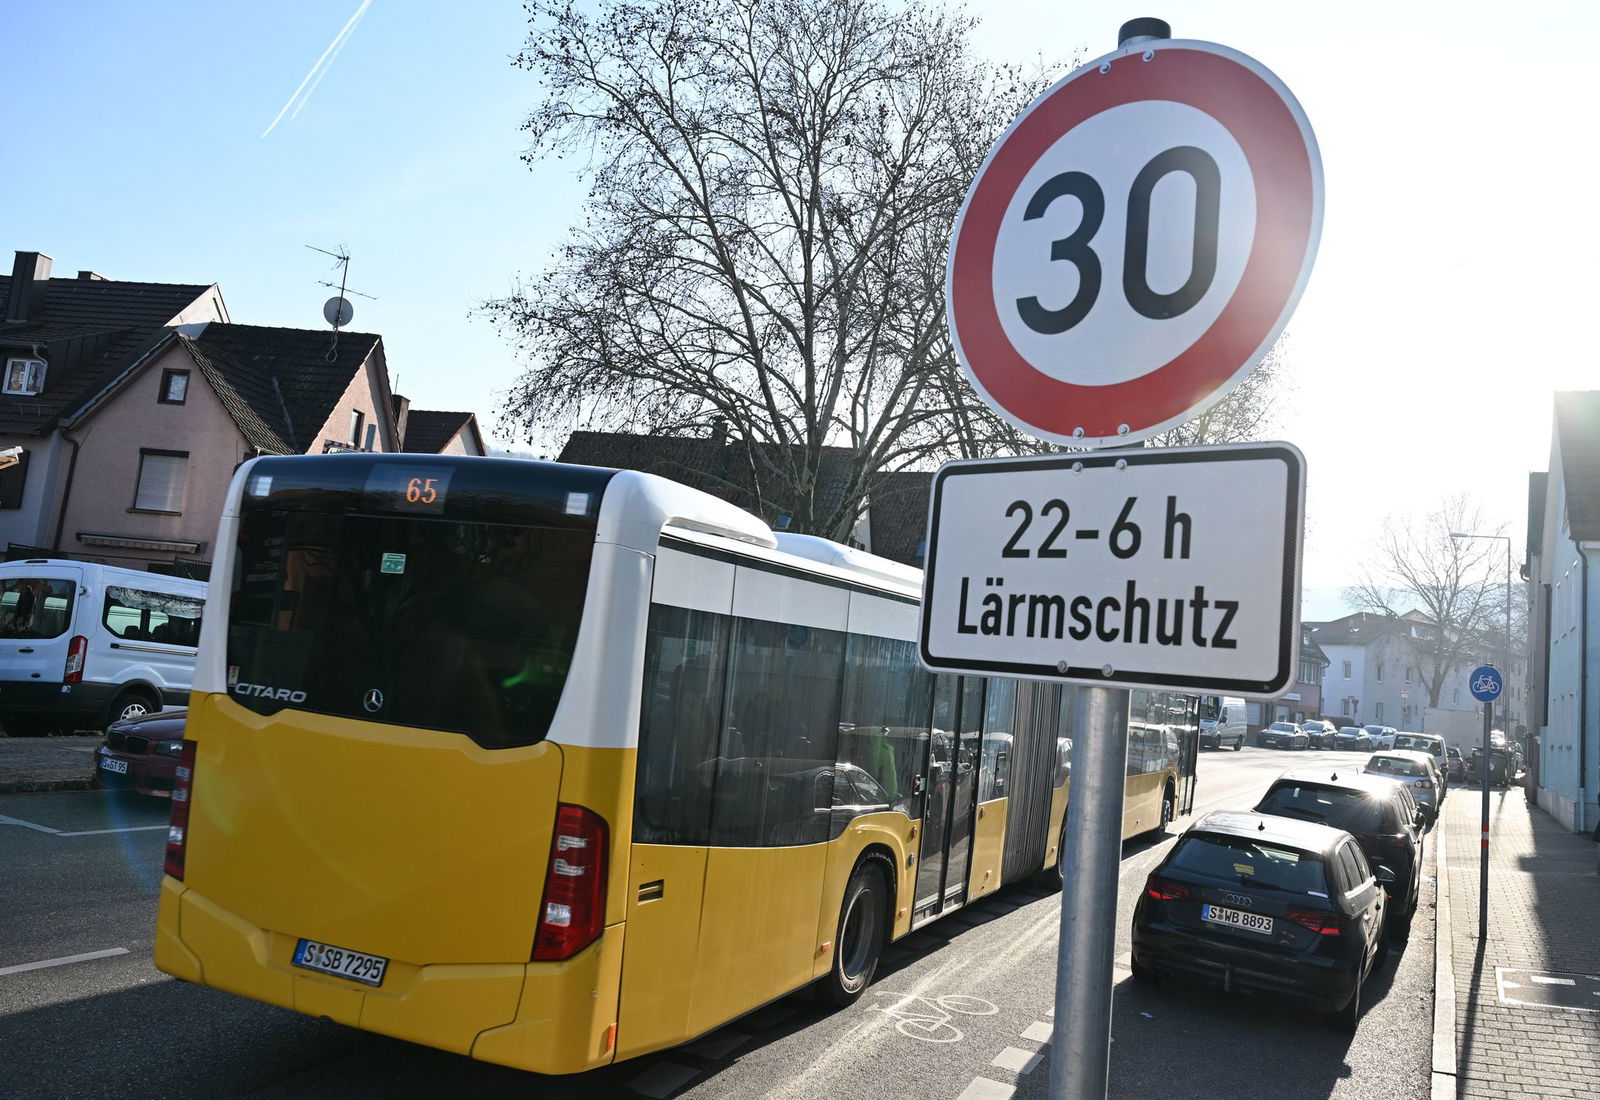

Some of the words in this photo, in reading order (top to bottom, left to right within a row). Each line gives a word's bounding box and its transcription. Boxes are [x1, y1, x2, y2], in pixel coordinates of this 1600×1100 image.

[1016, 145, 1221, 335] 30
[406, 478, 438, 504] 65
[1002, 496, 1142, 560] 22-6
[1163, 495, 1193, 560] h
[957, 576, 1240, 650] Lärmschutz
[235, 683, 307, 703] CITARO
[1209, 906, 1218, 919] S
[1224, 910, 1240, 923] WB
[1242, 914, 1272, 931] 8893
[304, 944, 316, 963] S
[322, 948, 343, 970] SB
[344, 953, 384, 980] 7295
